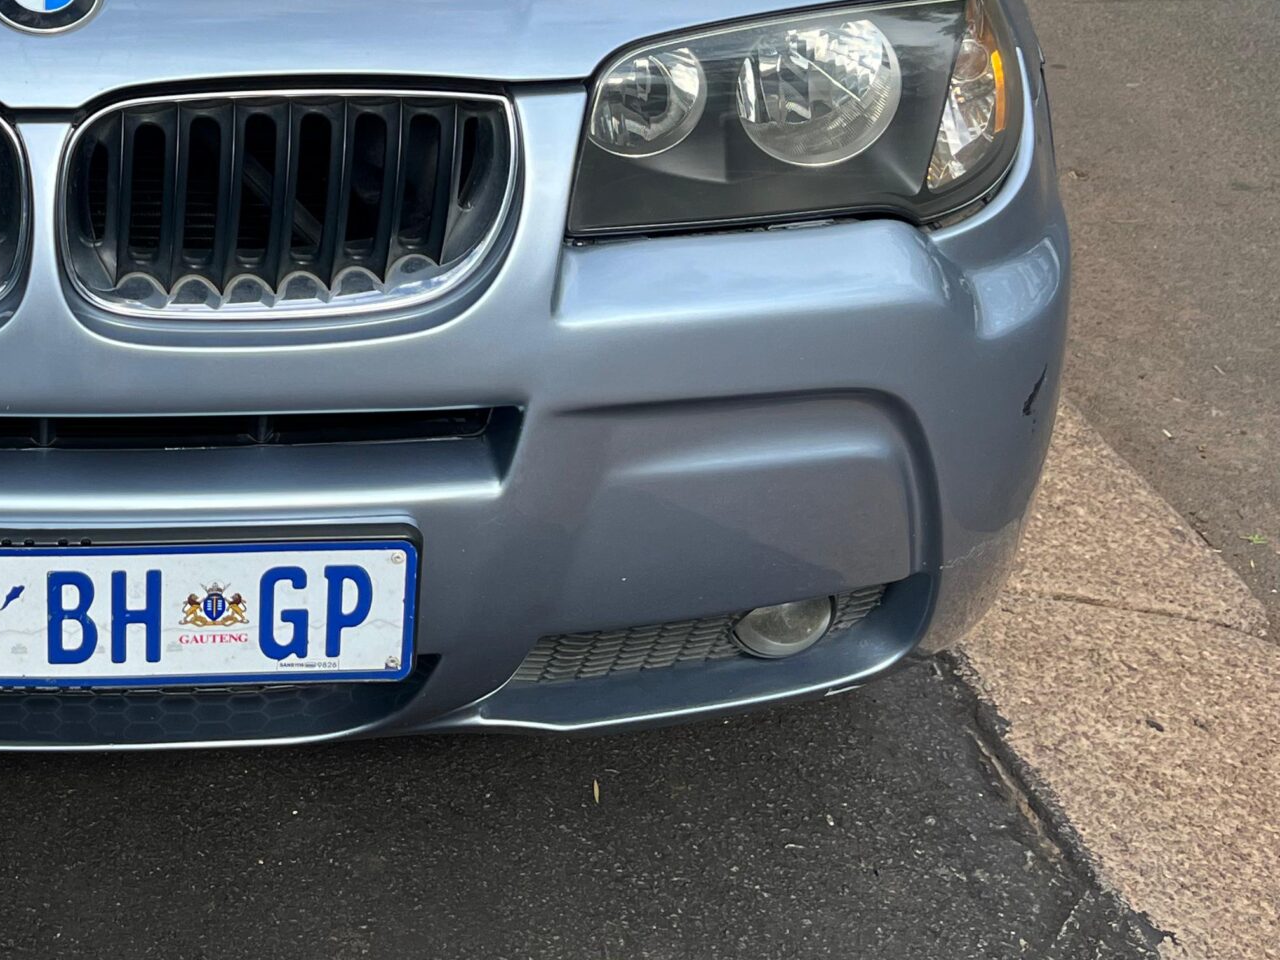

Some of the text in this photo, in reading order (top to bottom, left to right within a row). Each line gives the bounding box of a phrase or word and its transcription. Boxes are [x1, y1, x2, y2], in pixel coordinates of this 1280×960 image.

[47, 569, 163, 665] BH
[179, 633, 249, 645] GAUTENG
[257, 564, 374, 661] GP
